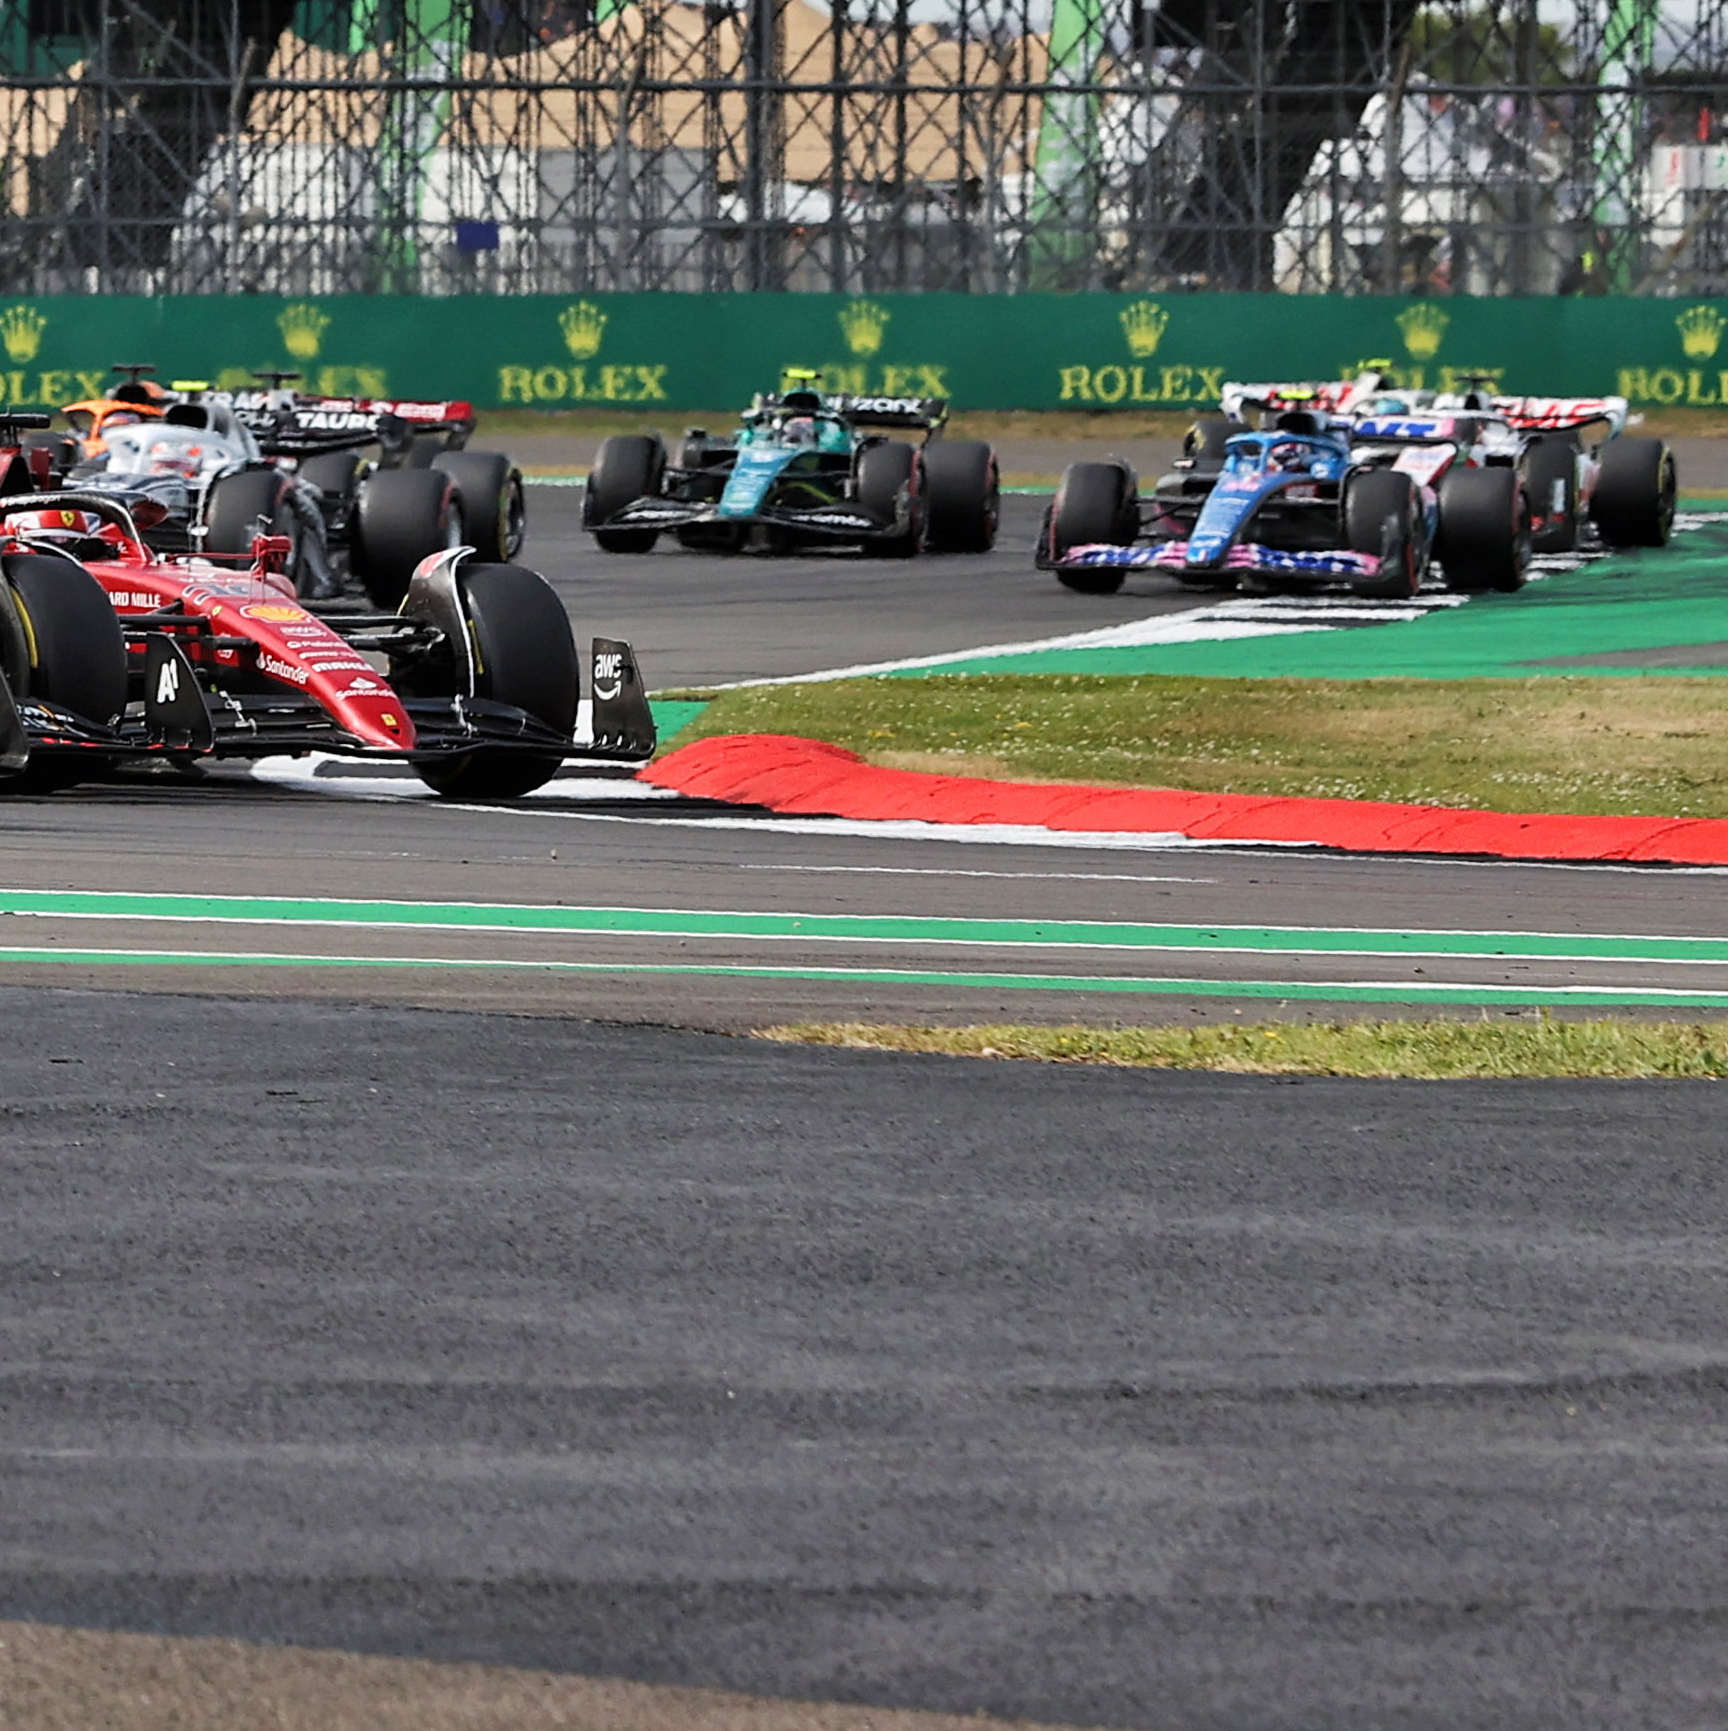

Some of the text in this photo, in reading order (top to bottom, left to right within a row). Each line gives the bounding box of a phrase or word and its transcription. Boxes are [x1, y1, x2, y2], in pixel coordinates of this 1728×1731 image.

[499, 366, 668, 402] ROLEX
[1059, 365, 1227, 402] ROLEX
[1618, 368, 1728, 405] ROL
[131, 593, 161, 608] MILLE
[265, 655, 309, 685] Santander
[594, 653, 623, 679] aws
